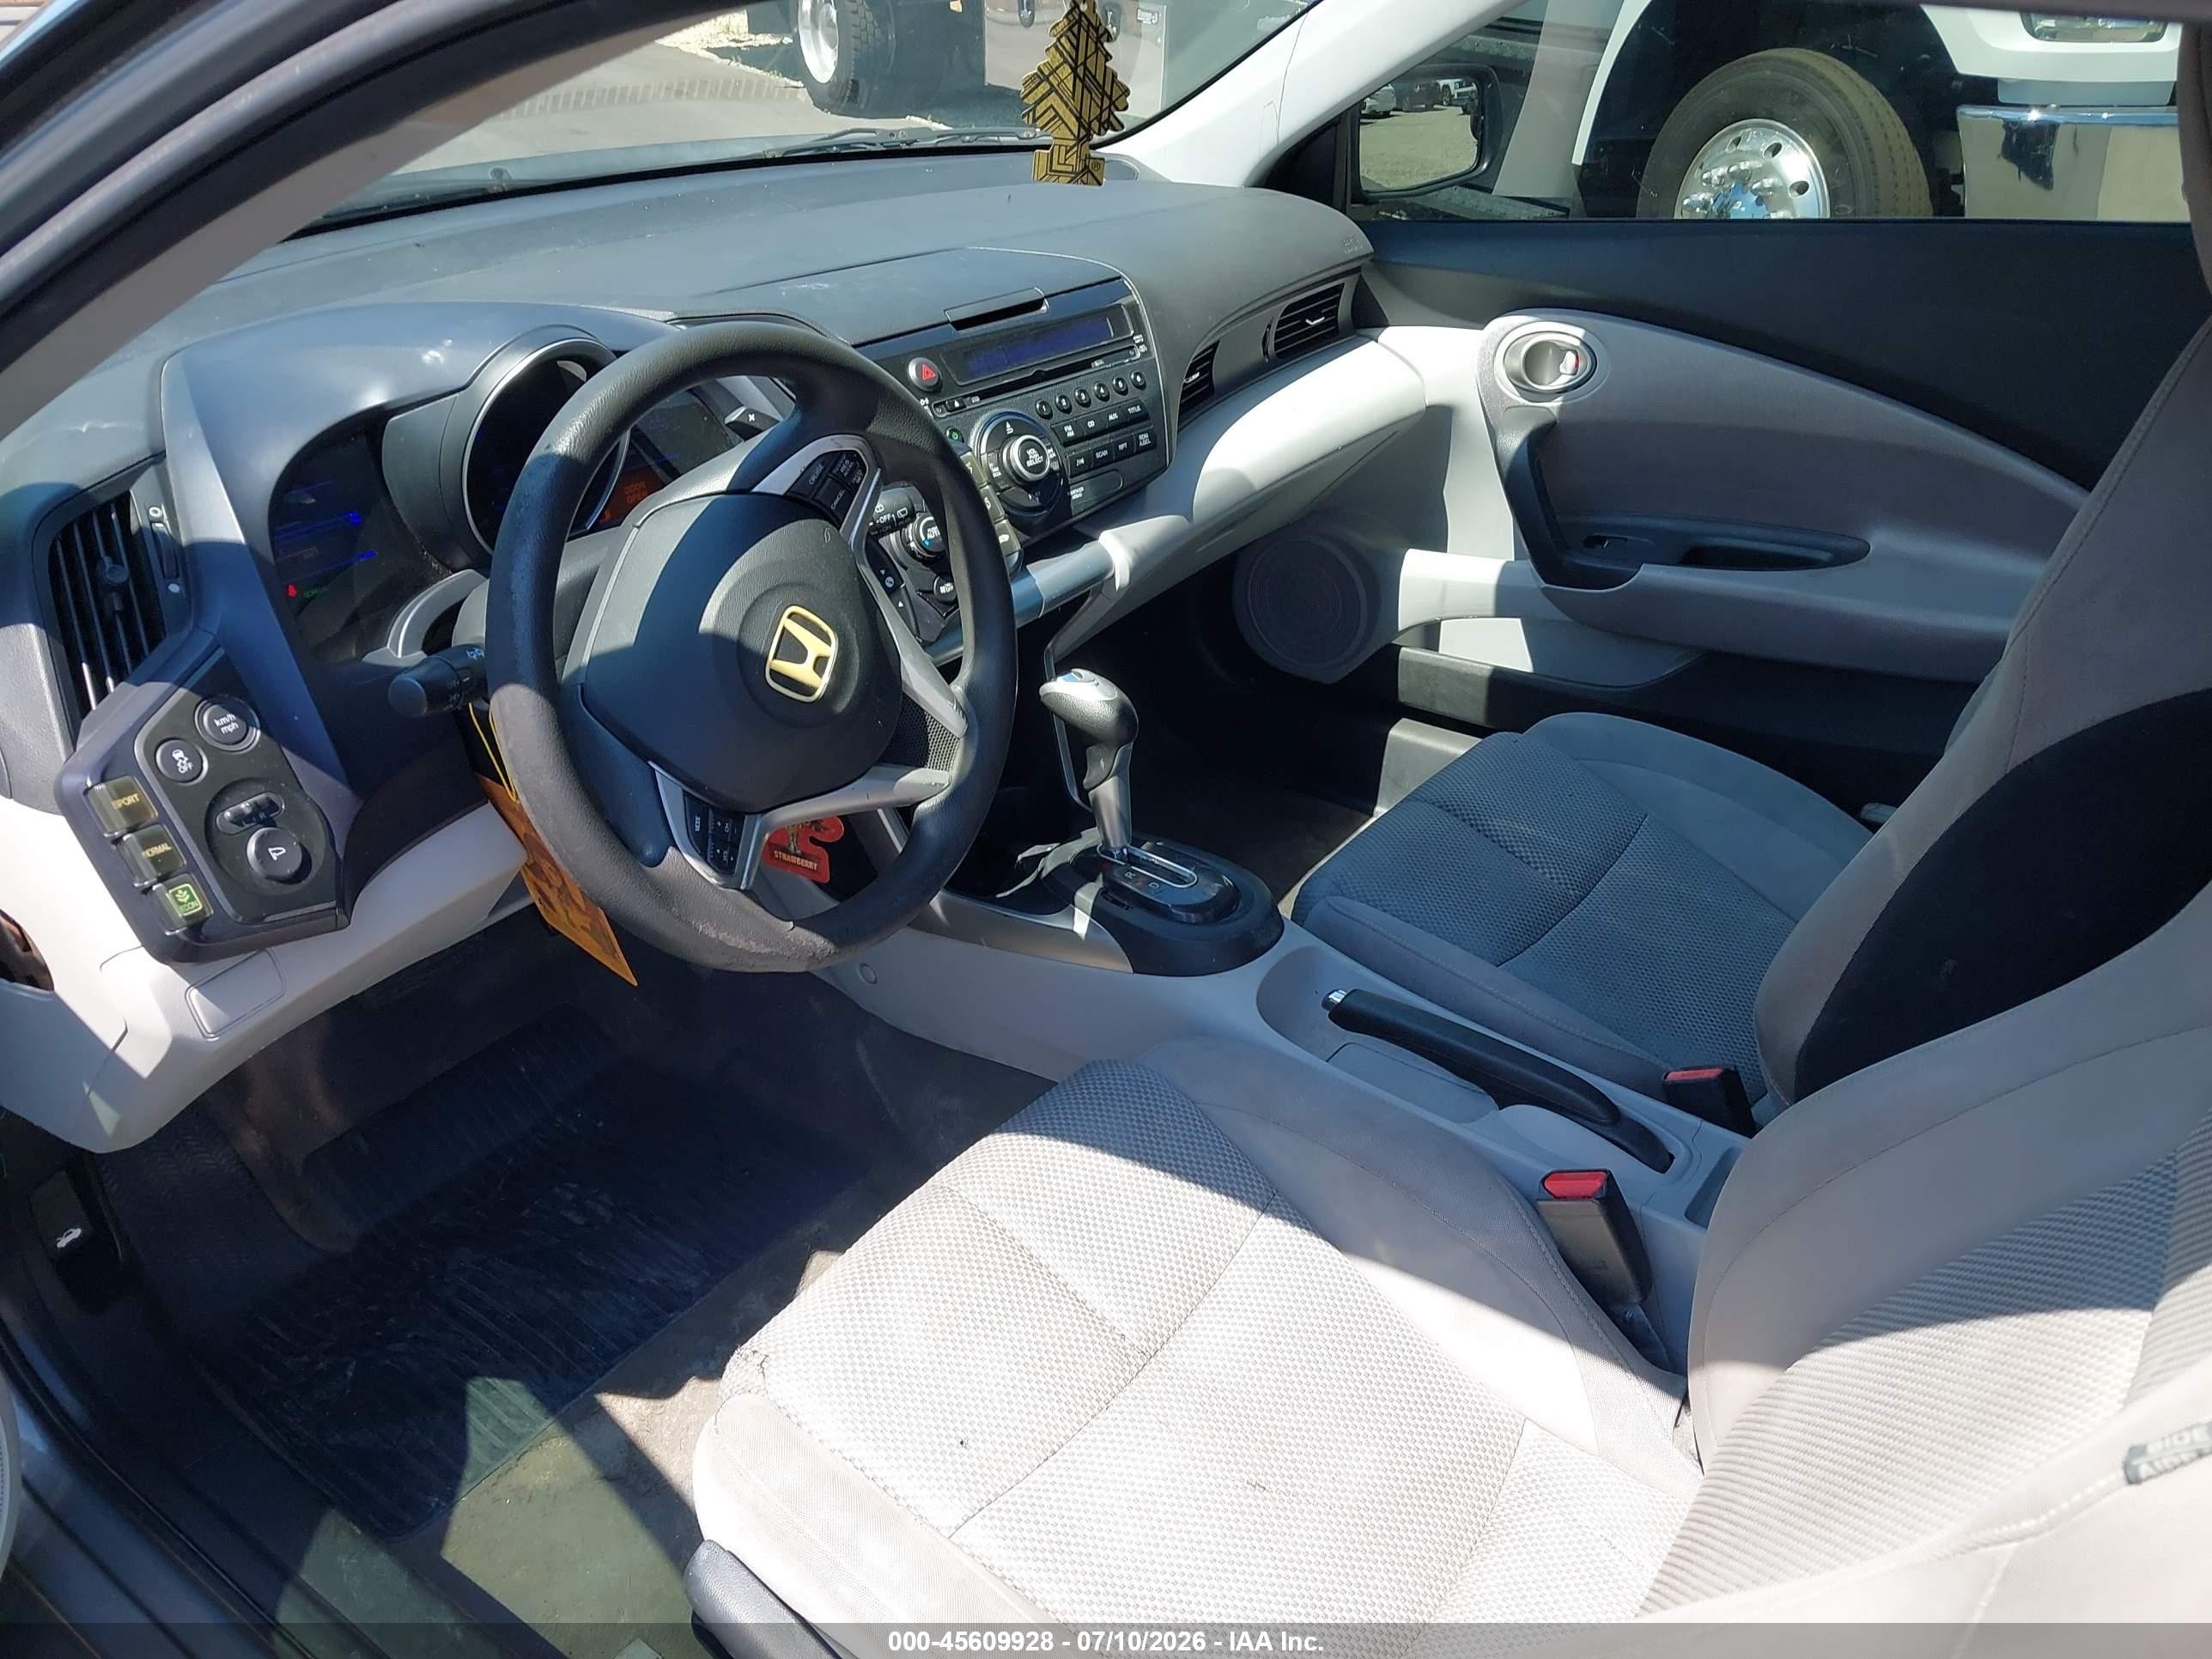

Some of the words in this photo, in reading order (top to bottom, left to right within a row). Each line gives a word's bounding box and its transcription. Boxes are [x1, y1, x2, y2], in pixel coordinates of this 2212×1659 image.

[1127, 404, 1142, 415] TITLE
[1086, 420, 1096, 428] CD
[1095, 449, 1109, 459] SCAN
[830, 489, 846, 509] CANCEL
[878, 514, 891, 524] OFF
[213, 713, 237, 727] km/h
[220, 722, 240, 734] mph
[178, 762, 193, 774] OFF
[110, 793, 141, 811] SPORT
[774, 850, 818, 871] STRAWBERRY
